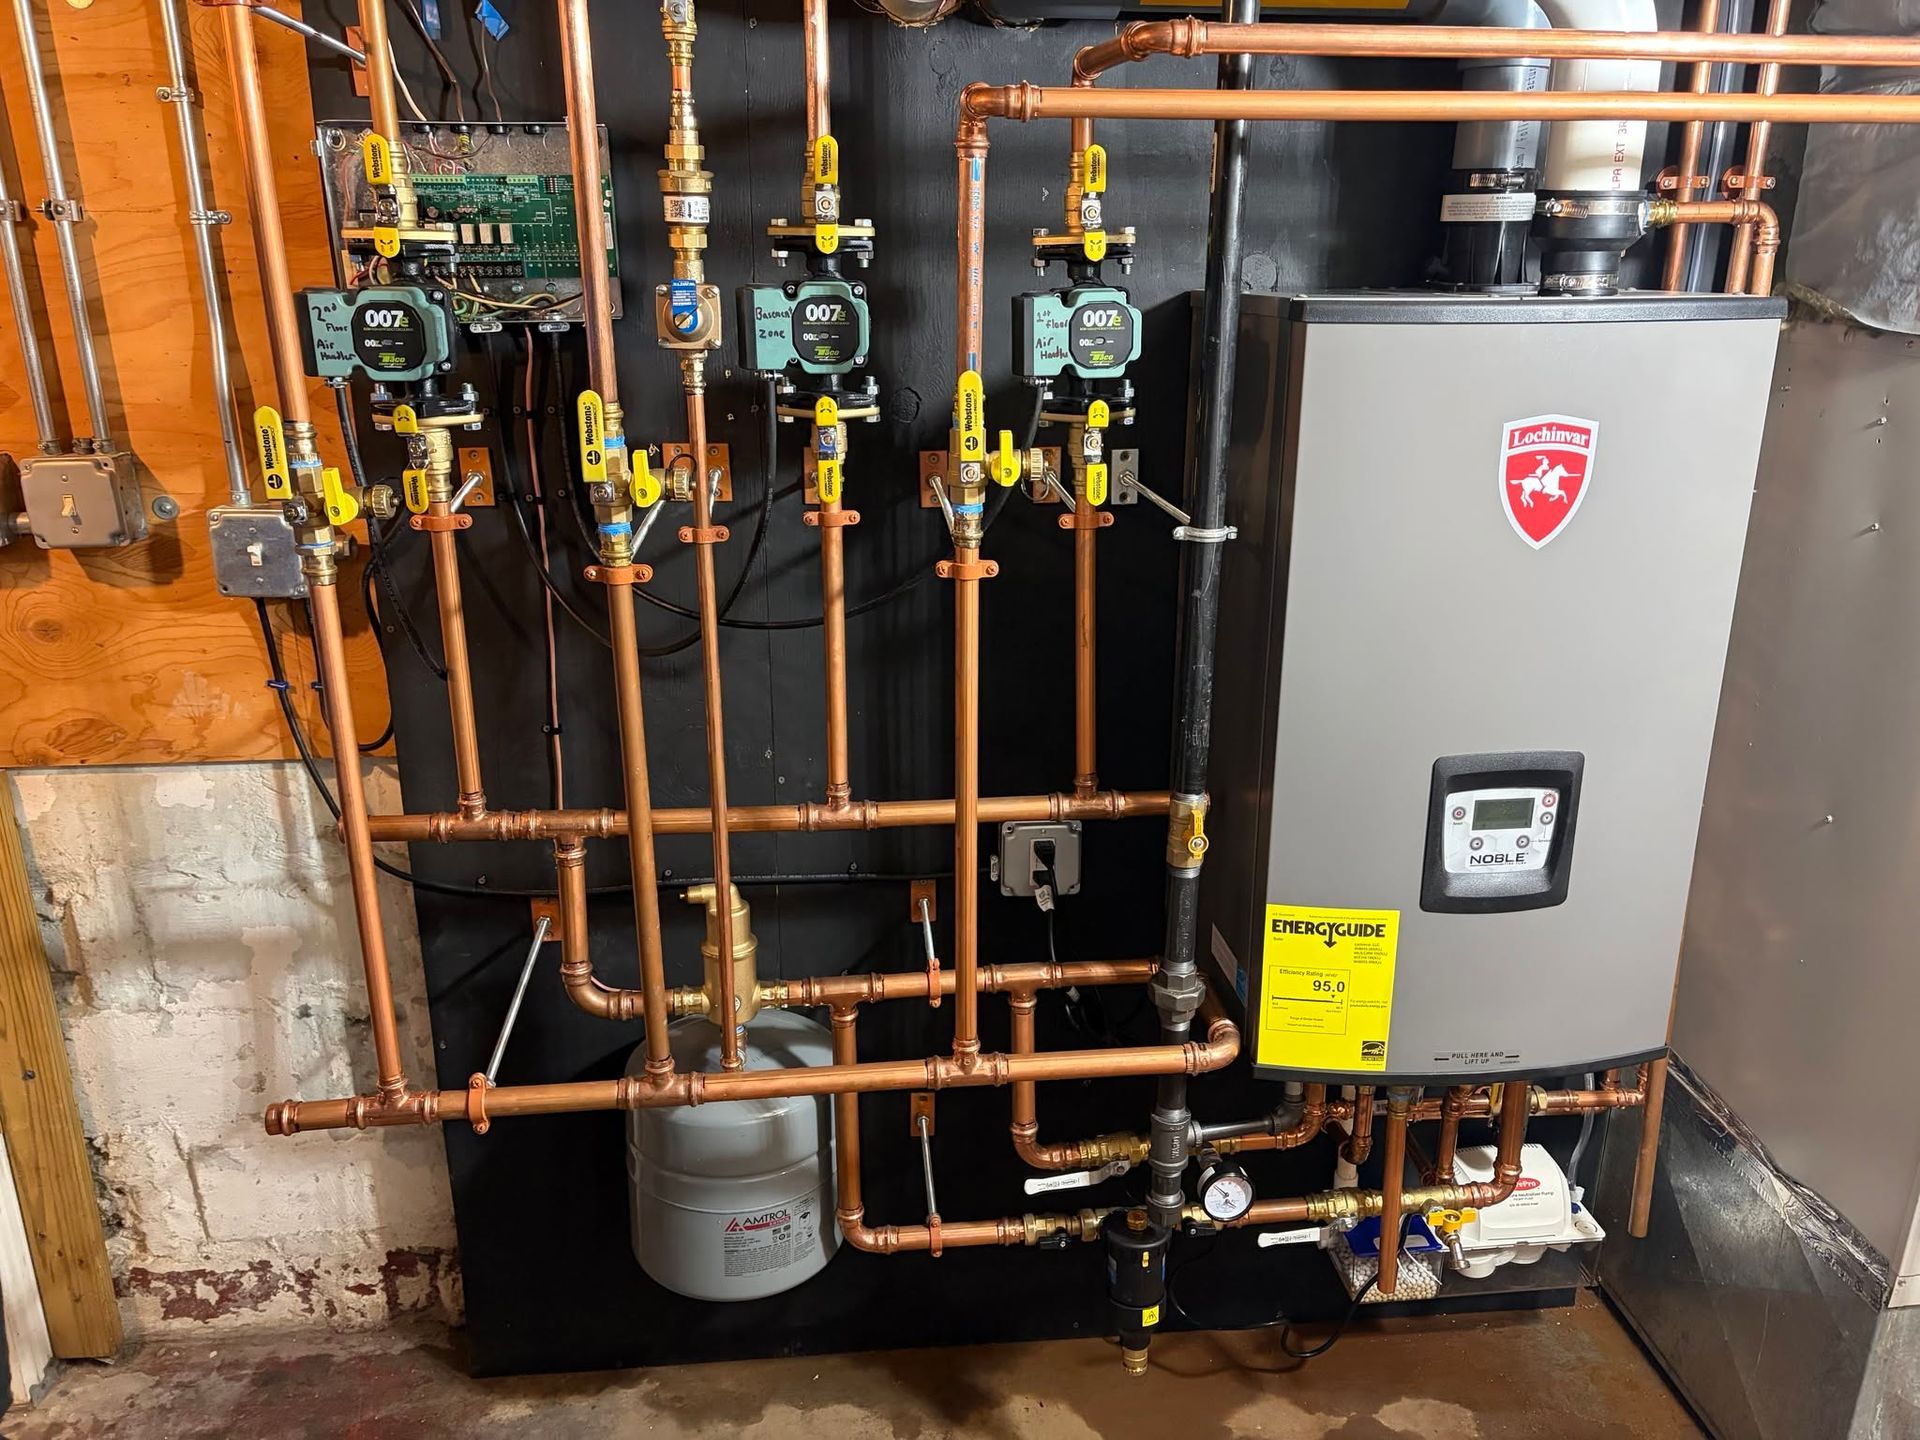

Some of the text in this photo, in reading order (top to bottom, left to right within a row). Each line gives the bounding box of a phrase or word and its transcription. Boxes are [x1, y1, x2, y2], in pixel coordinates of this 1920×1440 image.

[1614, 142, 1625, 162] EXT
[964, 391, 973, 432] Webstone
[584, 404, 594, 446] Webstone
[1512, 426, 1589, 447] Lochinvar
[260, 427, 274, 470] Webstone
[1470, 852, 1525, 865] NOBLE
[1272, 918, 1386, 940] ENERGYGUIDE
[1279, 968, 1305, 976] Efficiency
[1306, 970, 1324, 978] Rating
[1313, 980, 1345, 993] 95.0
[743, 1209, 789, 1226] AMTROL
